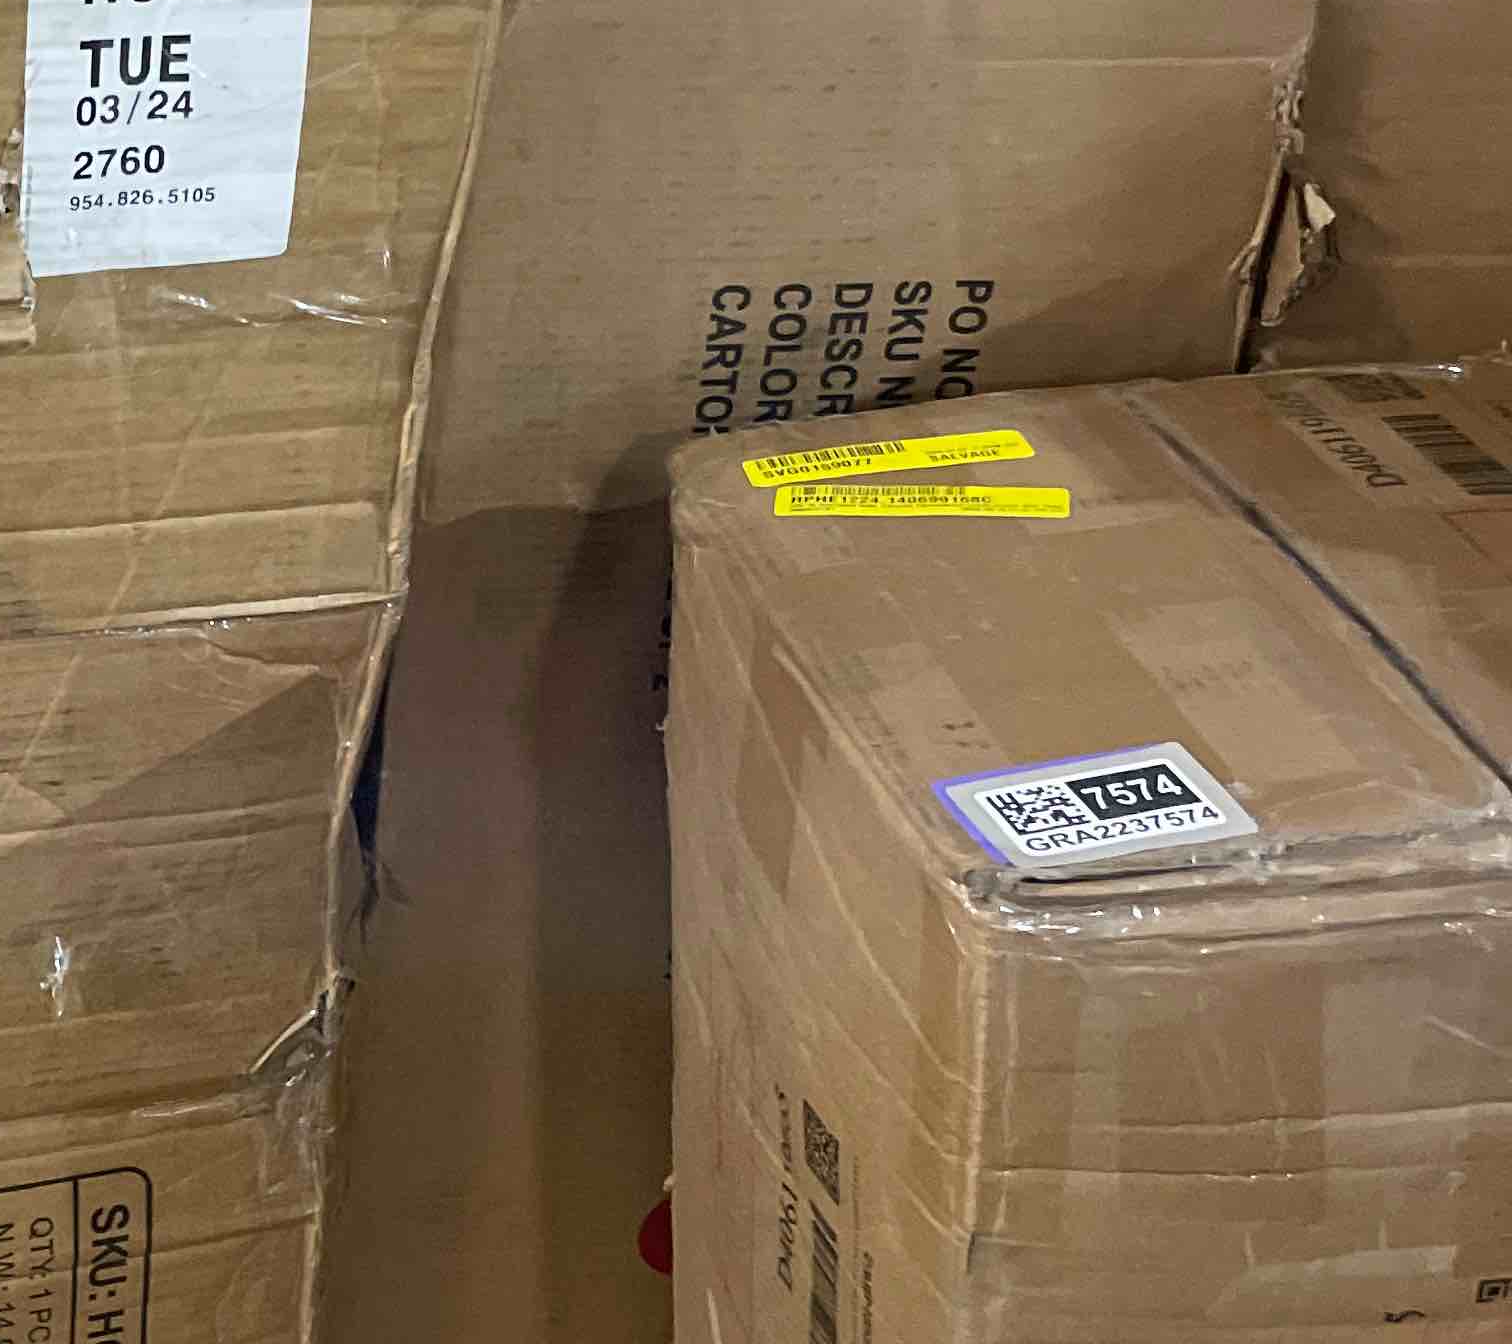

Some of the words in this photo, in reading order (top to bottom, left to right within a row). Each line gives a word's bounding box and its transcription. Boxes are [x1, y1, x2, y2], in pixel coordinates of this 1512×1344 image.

[80, 34, 192, 88] TUE
[75, 90, 194, 126] 03/24
[73, 144, 166, 180] 2760
[69, 186, 216, 211] 954.826.5105
[884, 281, 932, 361] SKU
[948, 280, 995, 335] PO
[753, 284, 813, 424] COLOR
[1081, 773, 1182, 811] 7574
[1026, 805, 1219, 852] GRA2237574
[27, 1216, 55, 1281] QTY:
[88, 1203, 131, 1302] SKU:
[28, 1287, 50, 1300] 1
